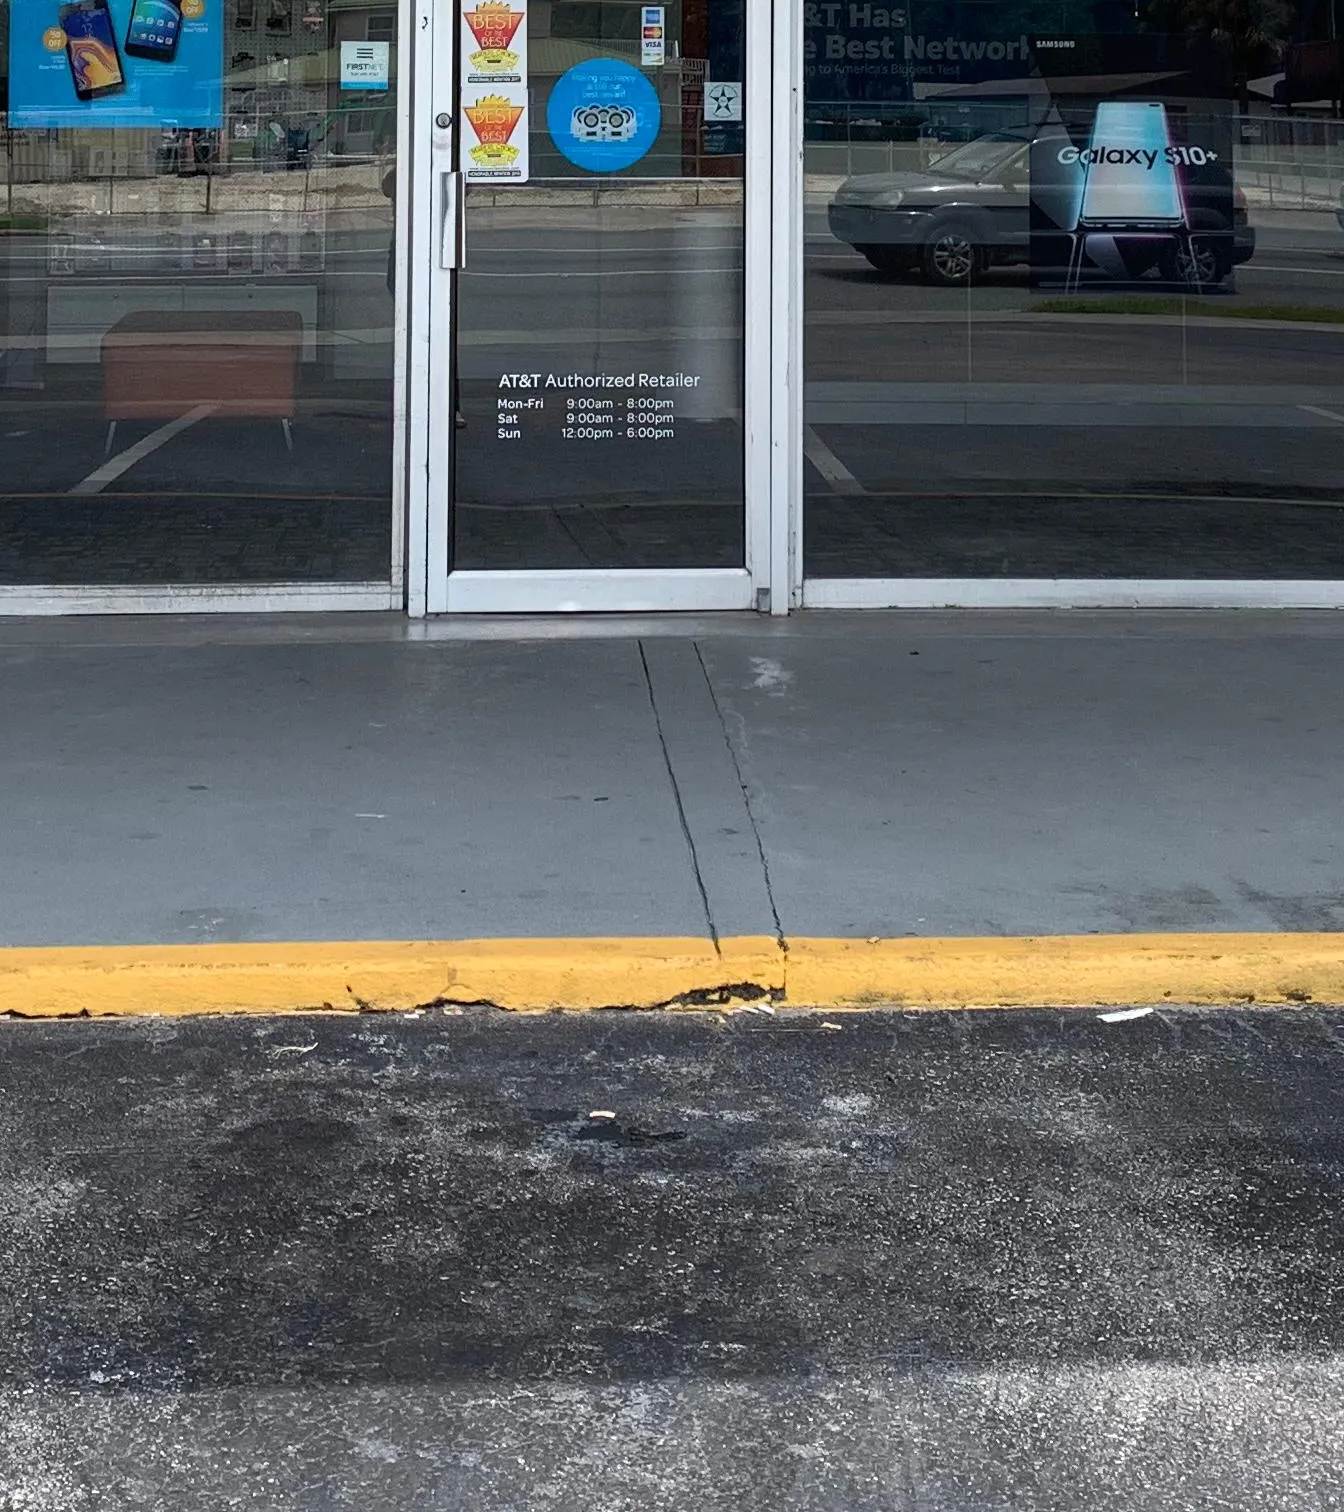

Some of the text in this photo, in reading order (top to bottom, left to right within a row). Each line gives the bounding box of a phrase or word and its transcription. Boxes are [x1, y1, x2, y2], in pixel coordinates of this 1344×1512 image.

[473, 14, 516, 29] BEST
[849, 3, 906, 28] Has
[481, 37, 508, 47] BEST
[825, 35, 895, 60] Best
[1036, 40, 1075, 48] SAMSUNG
[473, 109, 515, 124] BEST
[1057, 146, 1218, 170] Galaxy S10+
[498, 373, 700, 388] AT&T Authorized Retailer
[497, 398, 544, 409] Mon-Fri
[566, 398, 613, 409] 9:00am
[626, 398, 674, 410] 8:00pm
[497, 413, 518, 424] Sat
[566, 413, 613, 424] 9:00am
[626, 413, 674, 425] 8:00pm
[497, 428, 521, 439] Sun
[561, 428, 613, 440] 12:00pm
[626, 428, 674, 440] 6:00pm
